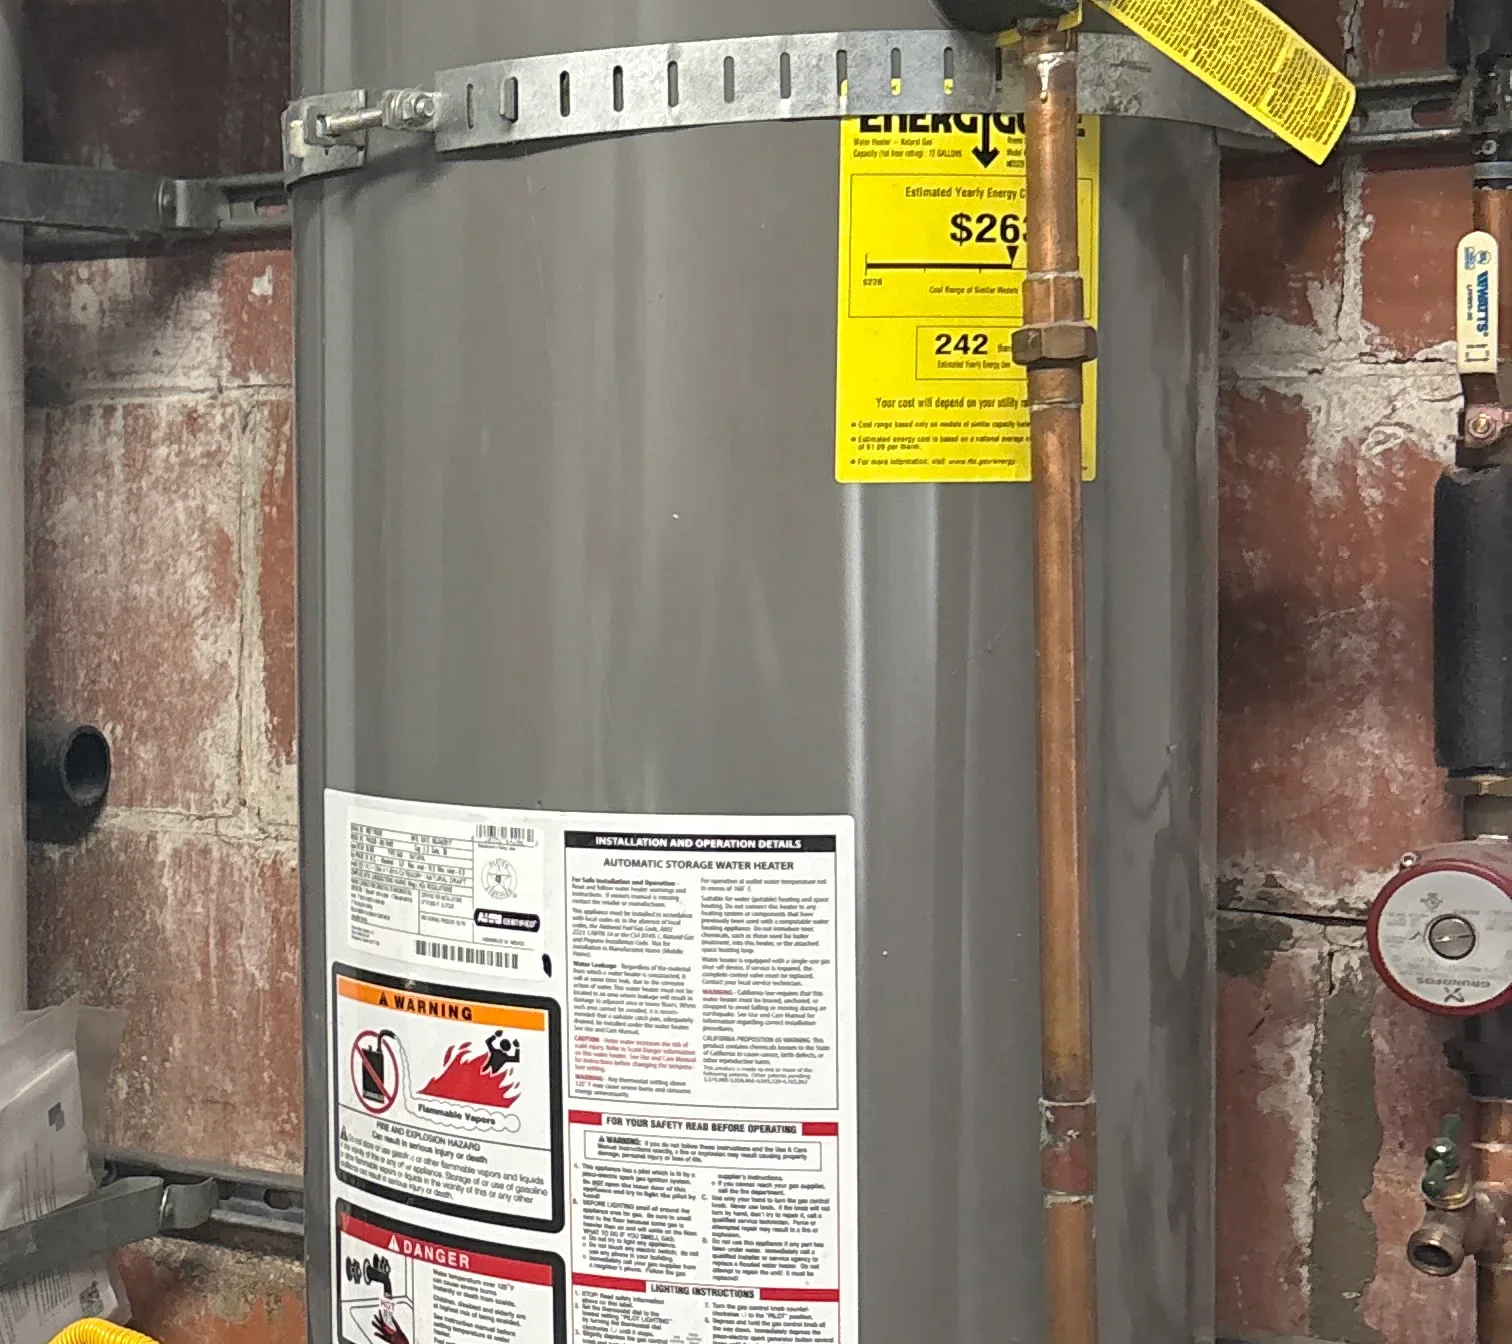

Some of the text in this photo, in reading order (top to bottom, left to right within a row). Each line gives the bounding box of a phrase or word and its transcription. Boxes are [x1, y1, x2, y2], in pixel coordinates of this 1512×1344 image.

[905, 187, 1017, 200] Estimated Yearly Energy
[1477, 270, 1489, 334] WATTS
[935, 333, 988, 355] 242
[876, 398, 1018, 411] Your cost will depend on your utility
[595, 836, 802, 849] INSTALLATION AND OPERATION DETAILS
[603, 857, 794, 870] AUTOMATIC STORAGE WATER HEATER
[394, 995, 473, 1021] WARNING
[418, 1103, 496, 1126] Flammable Vapors
[606, 1117, 797, 1134] FOR YOUR SAFETY READ BEFORE OPERATING
[406, 1129, 446, 1145] EXPLOSION
[448, 1138, 480, 1152] HAZARD
[409, 1140, 433, 1154] serious
[435, 1147, 454, 1161] injury
[403, 1240, 471, 1268] DANGER
[651, 1284, 754, 1298] LIGHTING INSTRUCTIONS
